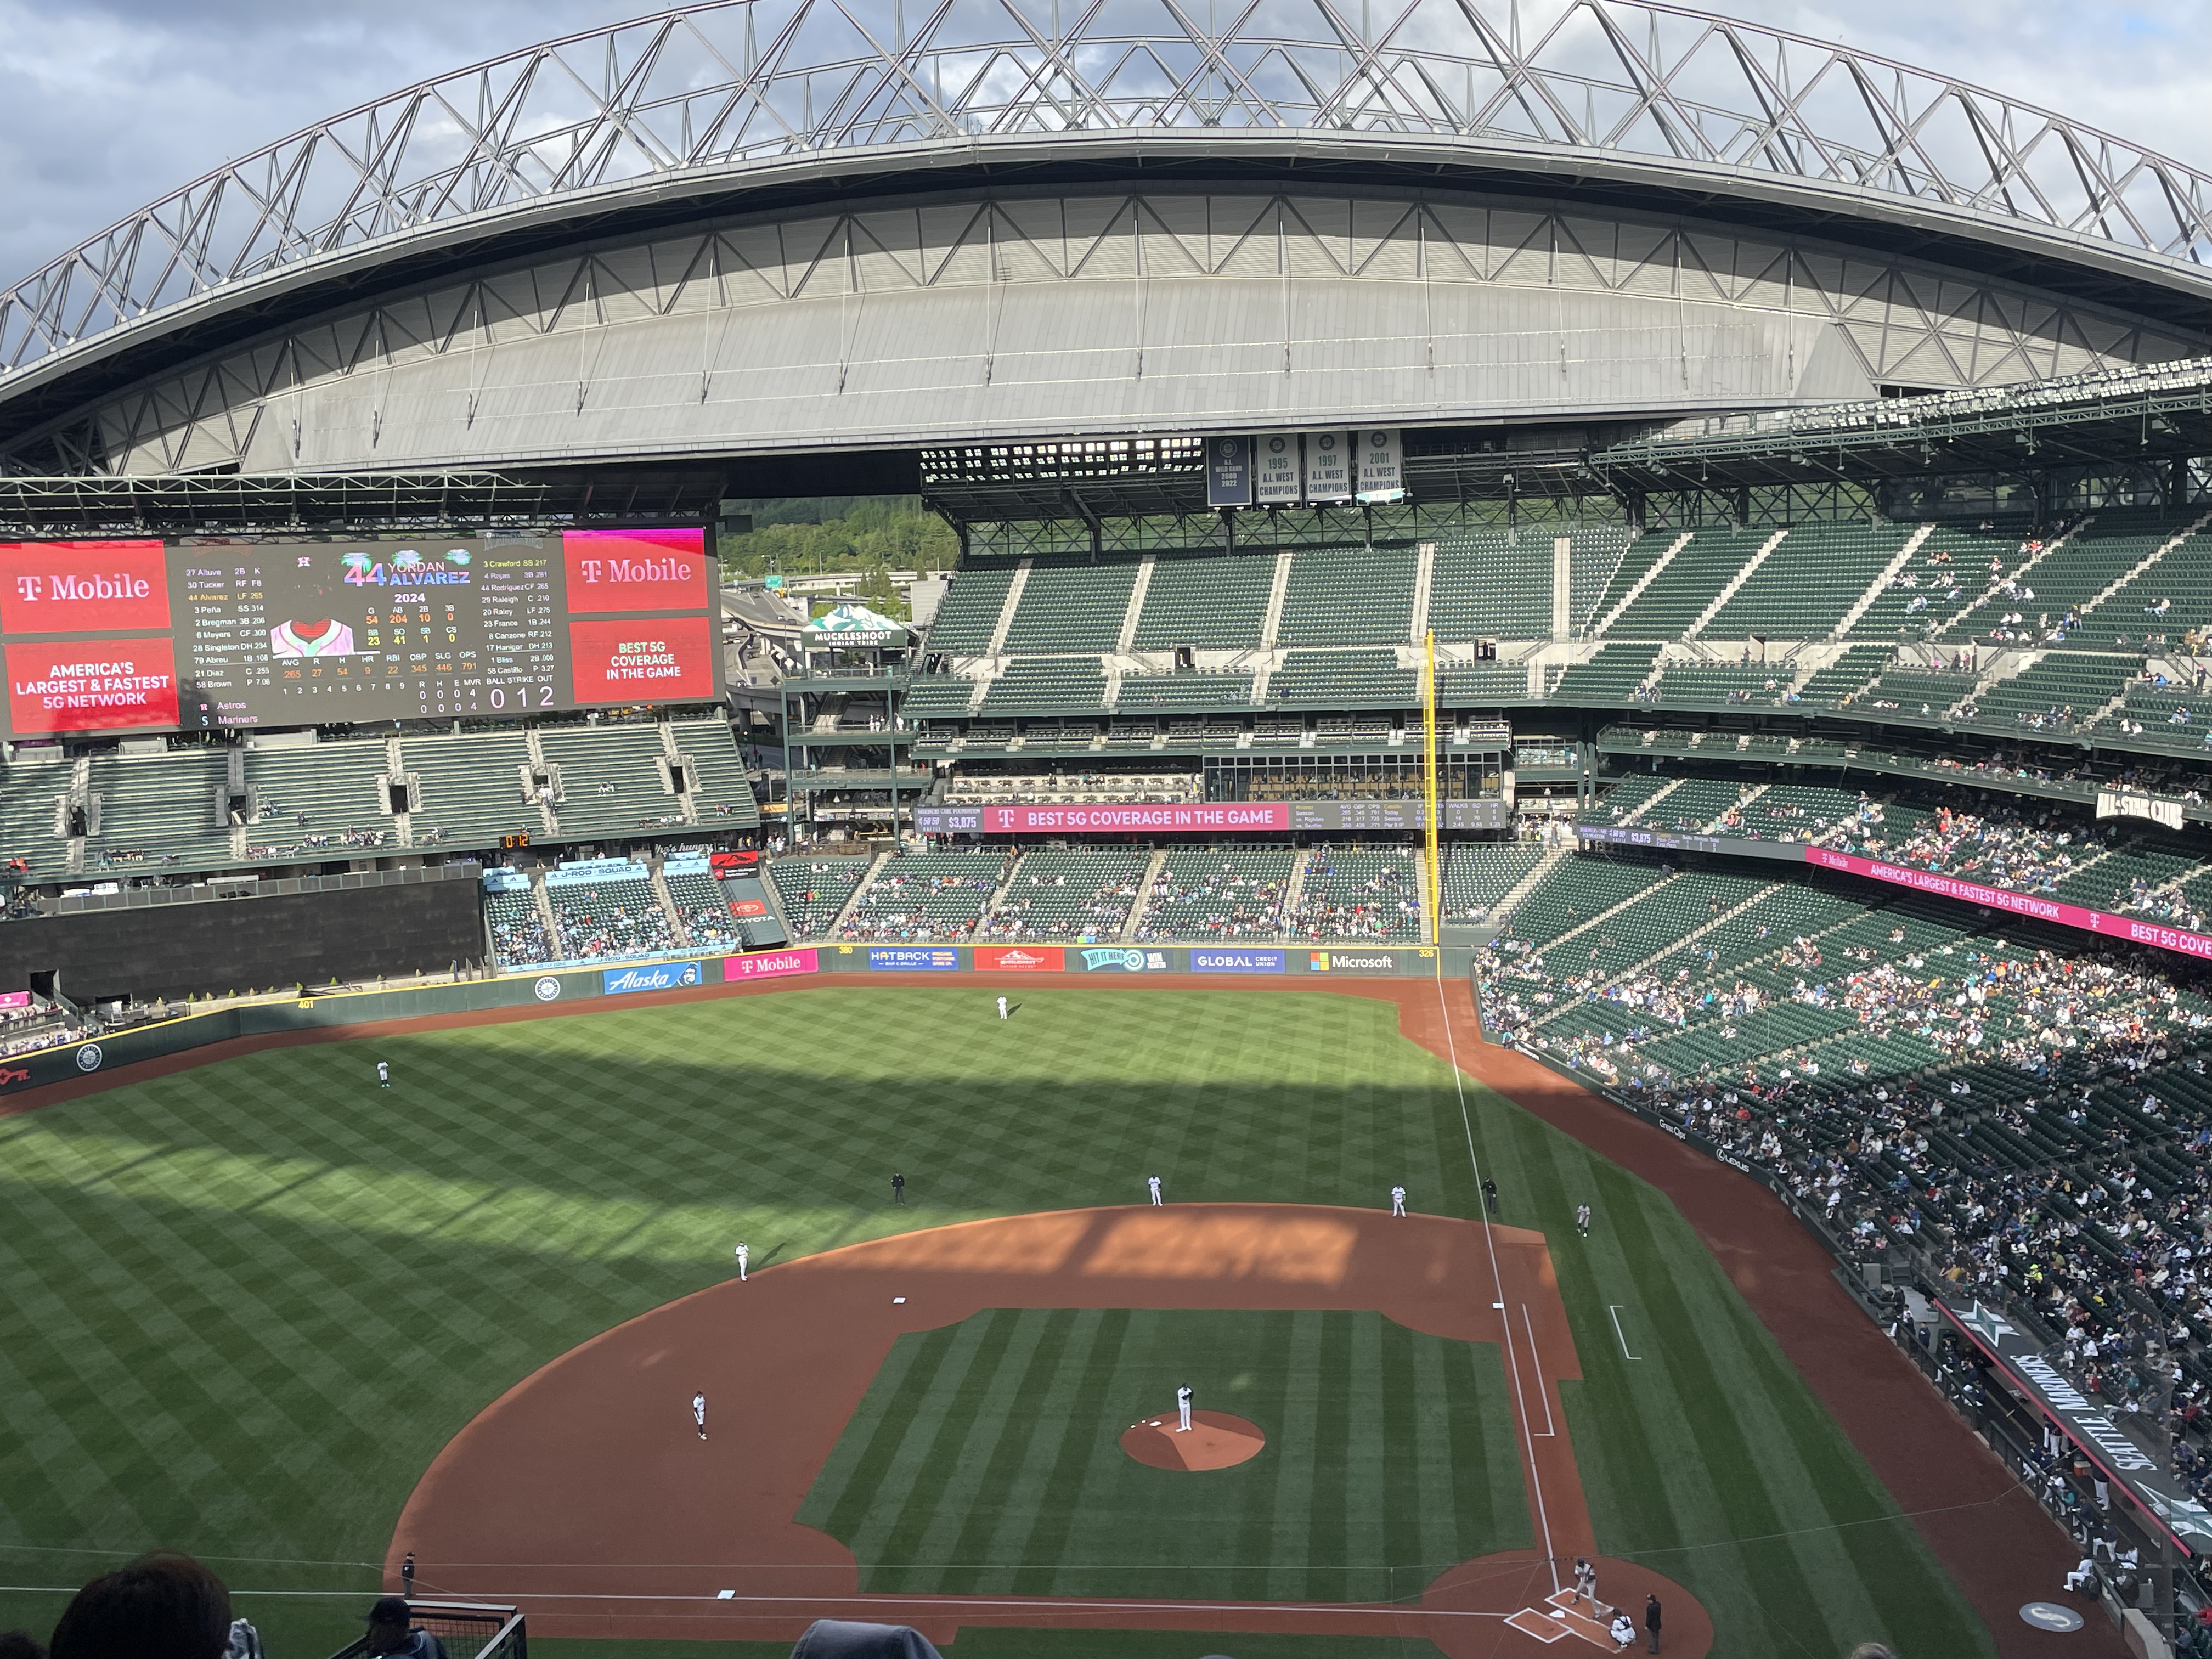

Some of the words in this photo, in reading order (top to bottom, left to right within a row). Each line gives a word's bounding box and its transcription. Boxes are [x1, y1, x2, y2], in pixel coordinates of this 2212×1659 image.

[1268, 458, 1288, 470] 1995
[1318, 455, 1337, 467] 1997
[1369, 452, 1389, 464] 2001
[1263, 473, 1274, 483] A.L.
[1276, 472, 1294, 482] WEST
[1312, 471, 1324, 481] A.L.
[1325, 470, 1343, 479] WEST
[1364, 468, 1375, 478] A.L.
[1376, 467, 1396, 477] WEST
[1260, 485, 1298, 496] CHAMPIONS
[1309, 482, 1347, 494] CHAMPIONS
[1360, 479, 1400, 491] CHAMPIONS
[343, 563, 387, 587] 44
[388, 562, 445, 573] YORDAN
[607, 558, 691, 583] Mobile
[390, 572, 470, 586] ALVAREZ
[48, 573, 150, 600] Mobile
[394, 593, 426, 603] 2024
[492, 596, 518, 604] Raleigh
[202, 619, 236, 627] Bregman
[366, 615, 379, 624] 54
[389, 614, 407, 624] 204
[419, 613, 431, 622] 10
[368, 636, 380, 646] 23
[393, 636, 405, 645] 41
[815, 631, 892, 641] MUCKLESHOOT
[205, 644, 239, 652] Singleton
[619, 642, 648, 654] BEST
[650, 641, 665, 653] 5G
[611, 653, 675, 667] COVERAGE
[50, 661, 134, 678] AMERICA'S
[387, 666, 398, 674] 22
[606, 669, 619, 680] IN
[620, 668, 644, 679] THE
[646, 666, 681, 678] GAME
[16, 680, 87, 695] LARGEST
[90, 679, 101, 692] &
[104, 675, 170, 691] FASTEST
[43, 696, 64, 709] 5G
[67, 692, 146, 708] NETWORK
[490, 689, 505, 708] 0
[517, 687, 526, 707] 1
[540, 686, 554, 706] 2
[217, 702, 246, 710] Astros
[218, 716, 258, 724] Mariners
[949, 817, 977, 829] $3,875
[1028, 812, 1064, 826] BEST
[1066, 812, 1087, 826] 5G
[1090, 811, 1171, 825] COVERAGE
[1176, 811, 1191, 824] IN
[1194, 811, 1224, 824] THE
[1228, 810, 1273, 824] GAME
[1829, 854, 1849, 868] Mobile
[1870, 864, 1912, 884] AMERICA'S
[1914, 873, 1951, 893] LARGEST
[1951, 882, 1958, 895] &
[1959, 884, 1996, 903] FASTEST
[1997, 893, 2010, 906] 5G
[2011, 896, 2059, 919] NETWORK
[2131, 923, 2159, 943] BEST
[2160, 931, 2176, 947] 5G
[871, 952, 930, 960] HATBACK
[1088, 952, 1100, 966] HIT
[1101, 952, 1108, 961] IT
[1109, 951, 1125, 960] HERE
[1147, 952, 1163, 963] WIN
[1419, 950, 1434, 958] 326
[756, 956, 801, 972] Mobile
[1198, 956, 1252, 966] GLOBAL
[1333, 955, 1392, 968] Microsoft
[610, 970, 669, 991] Alaska
[298, 1000, 314, 1009] 401
[1725, 1154, 1749, 1172] LEXUS
[2010, 1355, 2096, 1410] MARINERS
[2072, 1416, 2158, 1471] SEATTLE
